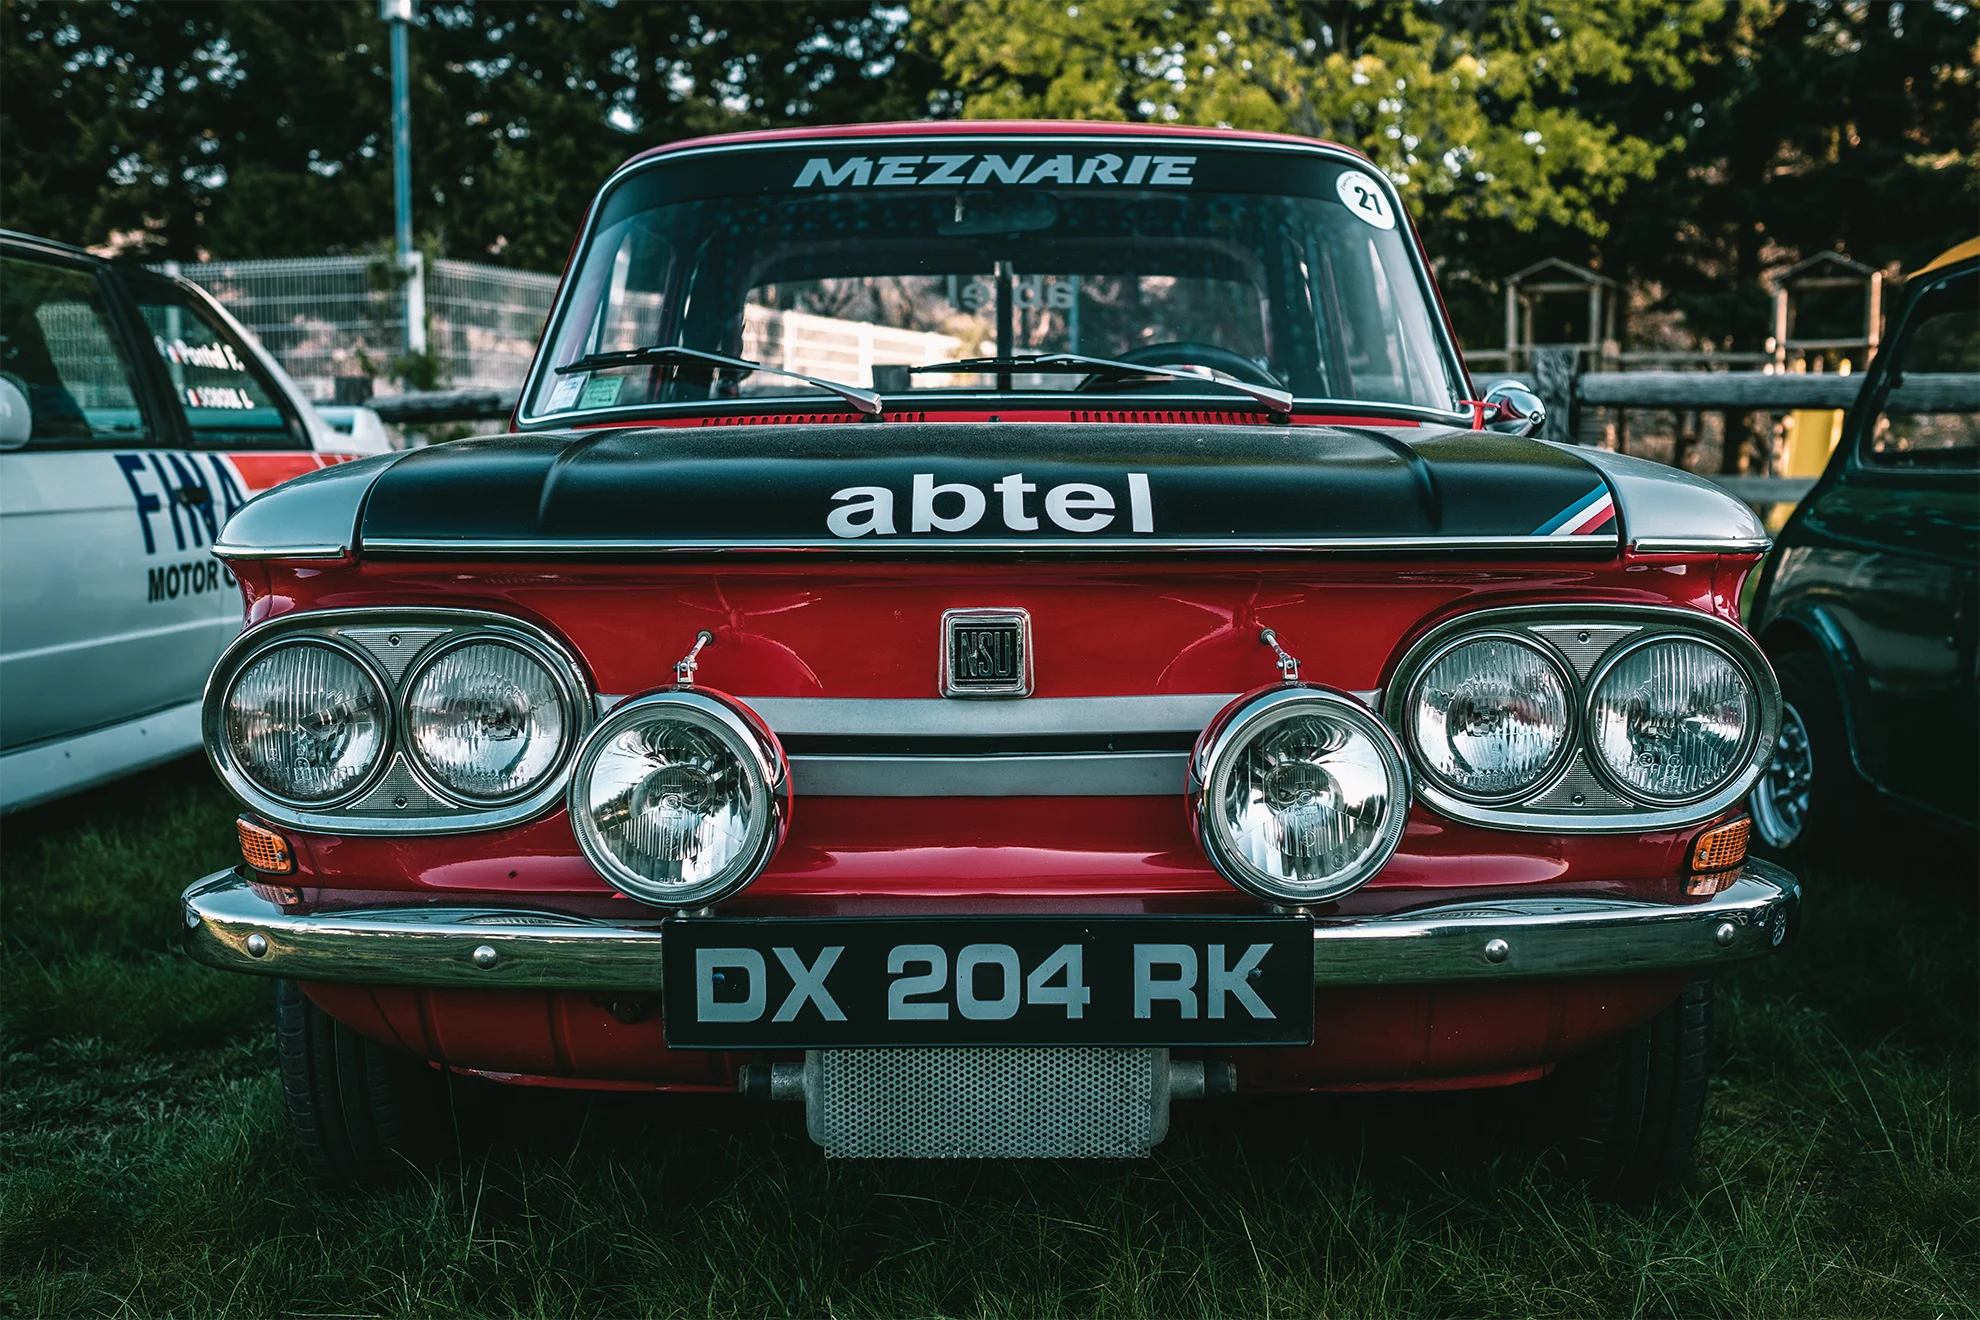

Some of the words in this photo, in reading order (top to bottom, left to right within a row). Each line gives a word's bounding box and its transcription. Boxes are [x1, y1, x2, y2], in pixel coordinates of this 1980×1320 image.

[792, 153, 1197, 187] MEZNARIE
[1354, 186, 1383, 216] 21
[827, 473, 1154, 538] abtel
[147, 560, 219, 604] MOTOR
[961, 631, 1011, 677] NSU
[696, 946, 848, 1023] DX
[887, 943, 1091, 1021] 204
[1134, 943, 1276, 1021] RK
